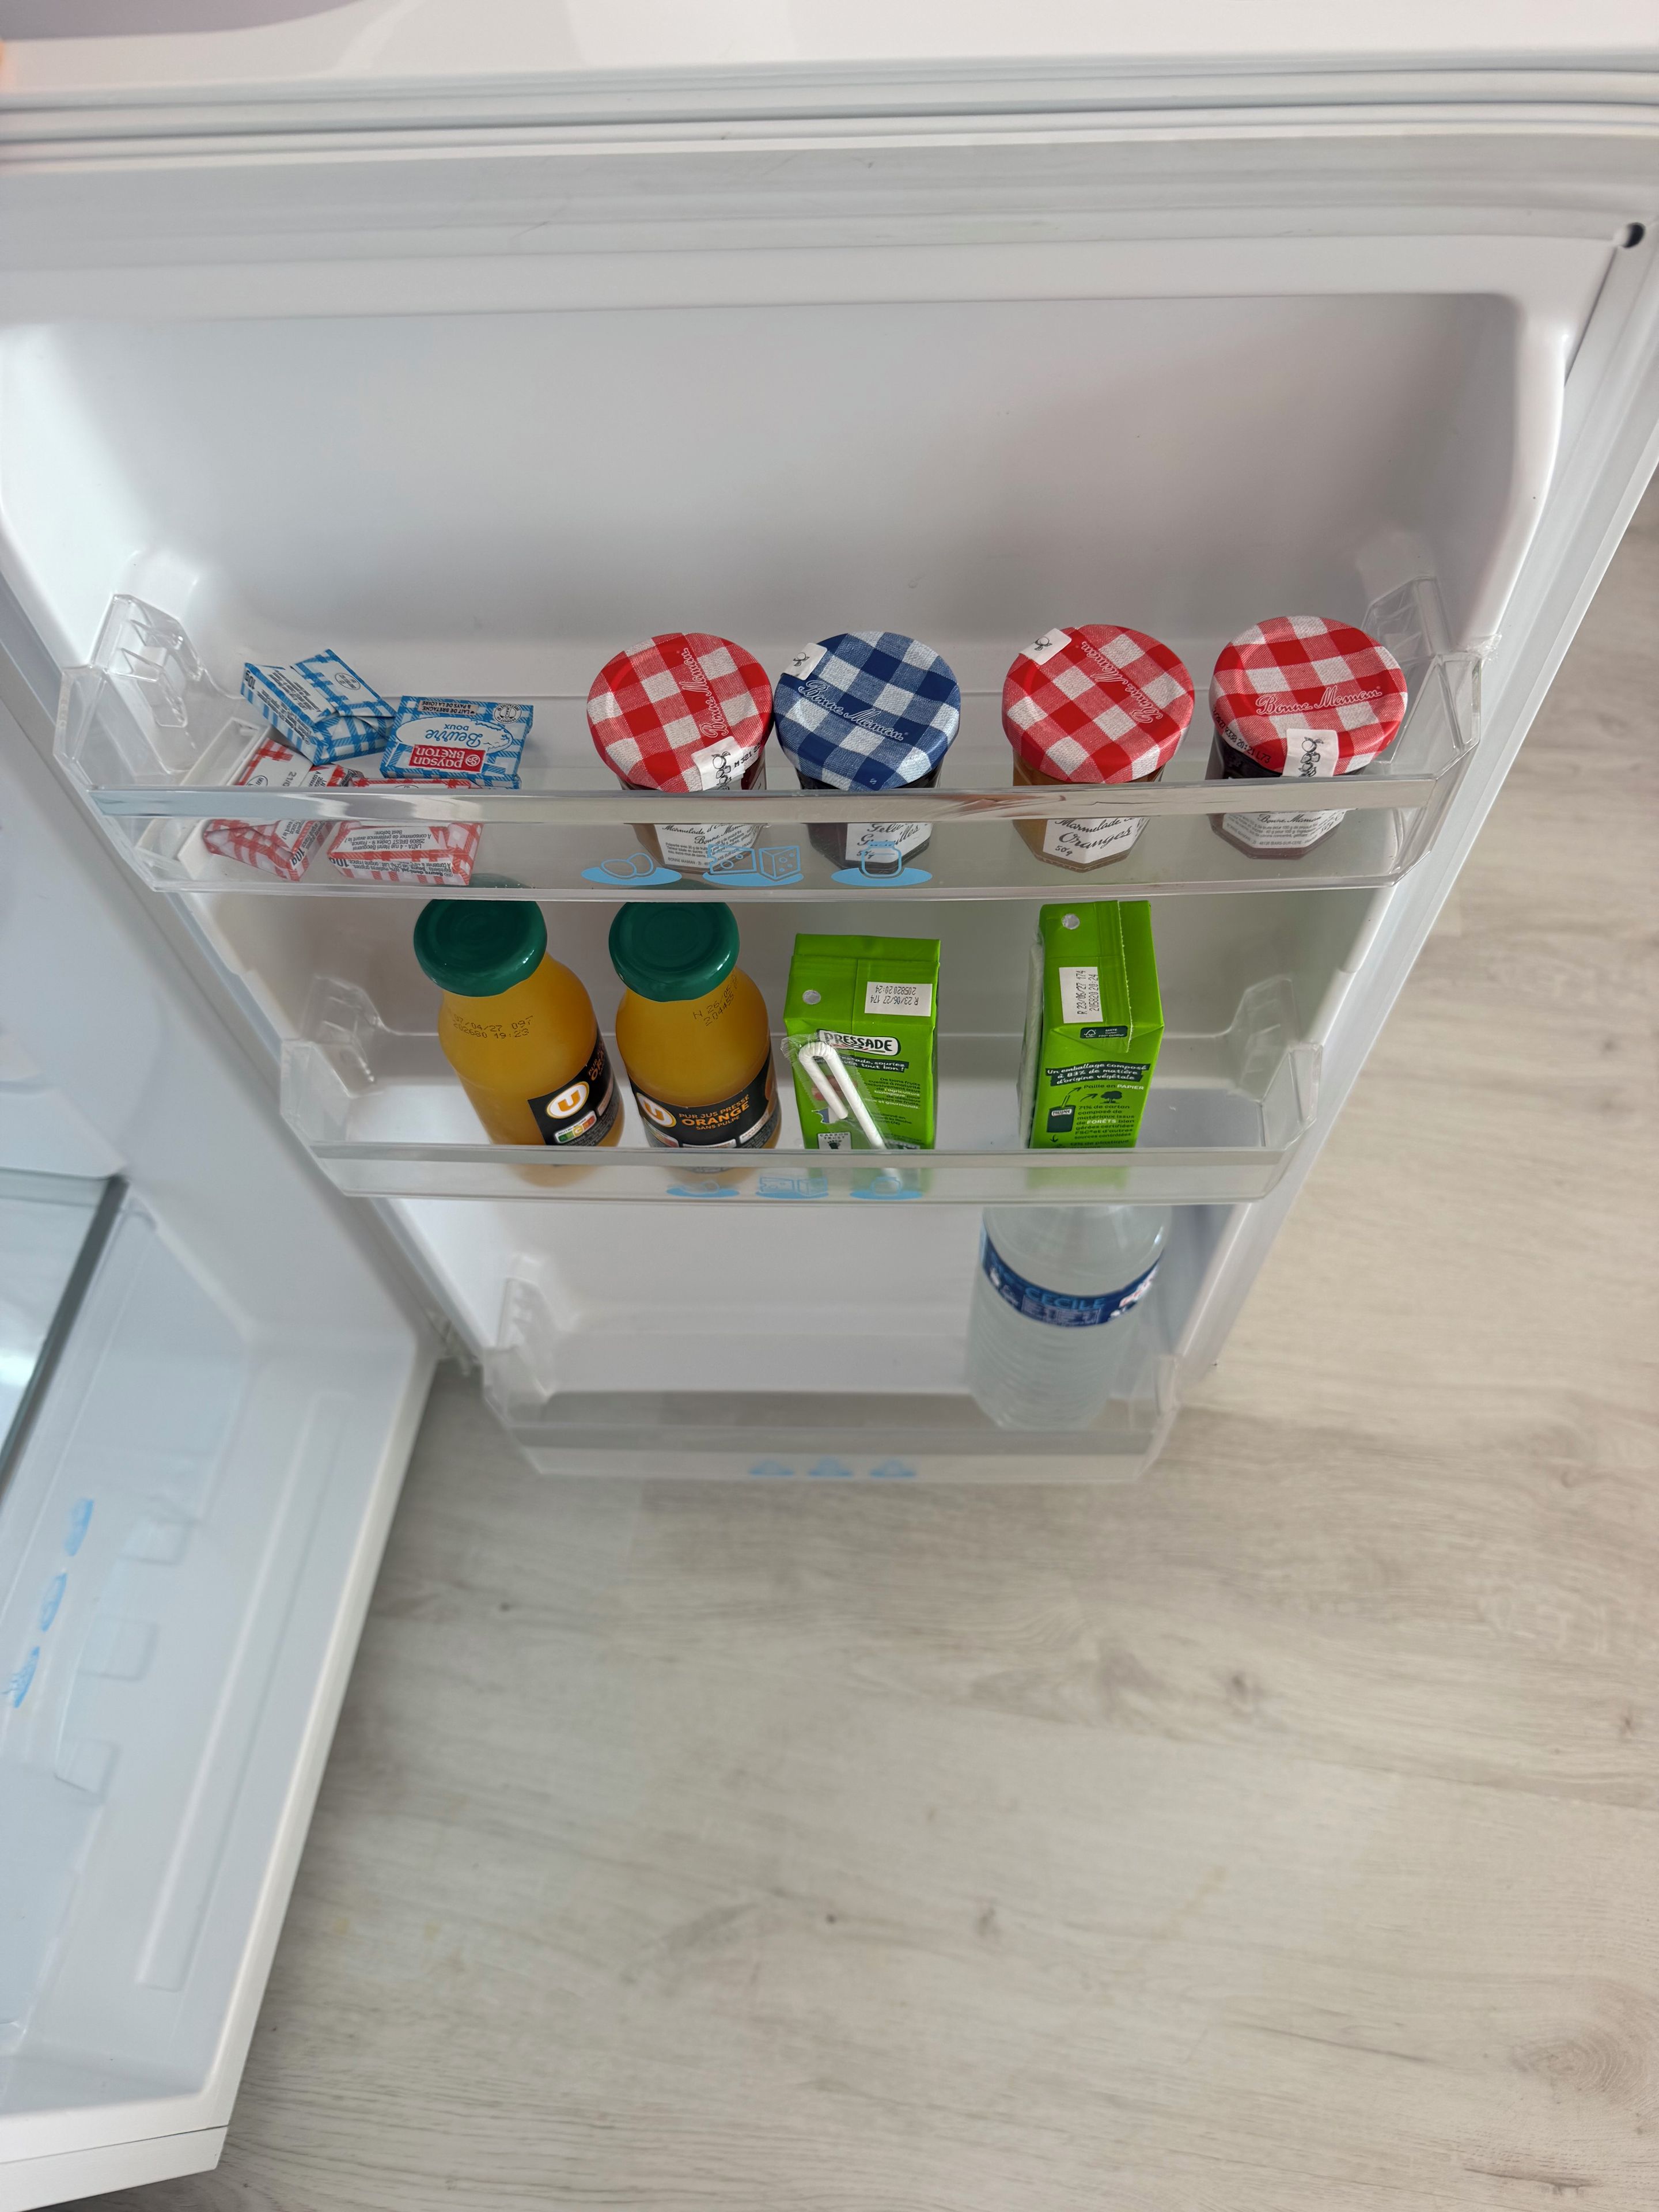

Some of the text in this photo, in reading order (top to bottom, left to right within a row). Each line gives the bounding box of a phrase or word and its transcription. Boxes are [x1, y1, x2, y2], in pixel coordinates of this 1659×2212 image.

[1081, 641, 1163, 723] Bonne Maman
[679, 647, 729, 738] Bonne Maman
[1255, 685, 1382, 715] Bonne Maman
[798, 680, 904, 741] Bonne Maman
[425, 729, 483, 748] Beurre
[415, 748, 465, 759] BRETON
[1055, 818, 1122, 833] Marmelade
[1257, 814, 1286, 823] Bonne
[694, 835, 721, 844] Bonne
[1059, 826, 1132, 849] Oranges
[1055, 845, 1073, 856] 50g
[1075, 971, 1086, 980] 174
[1088, 974, 1099, 991] 20:24
[875, 986, 916, 995] 205820 20:24
[883, 996, 912, 1005] 23/06/27
[914, 997, 919, 1005] R
[824, 1032, 893, 1051] PRESSADE
[1061, 1063, 1105, 1073] emballage
[1056, 1075, 1094, 1085] d'origine
[557, 1090, 581, 1112] U
[644, 1099, 665, 1121] U
[681, 1101, 749, 1126] ORANGE
